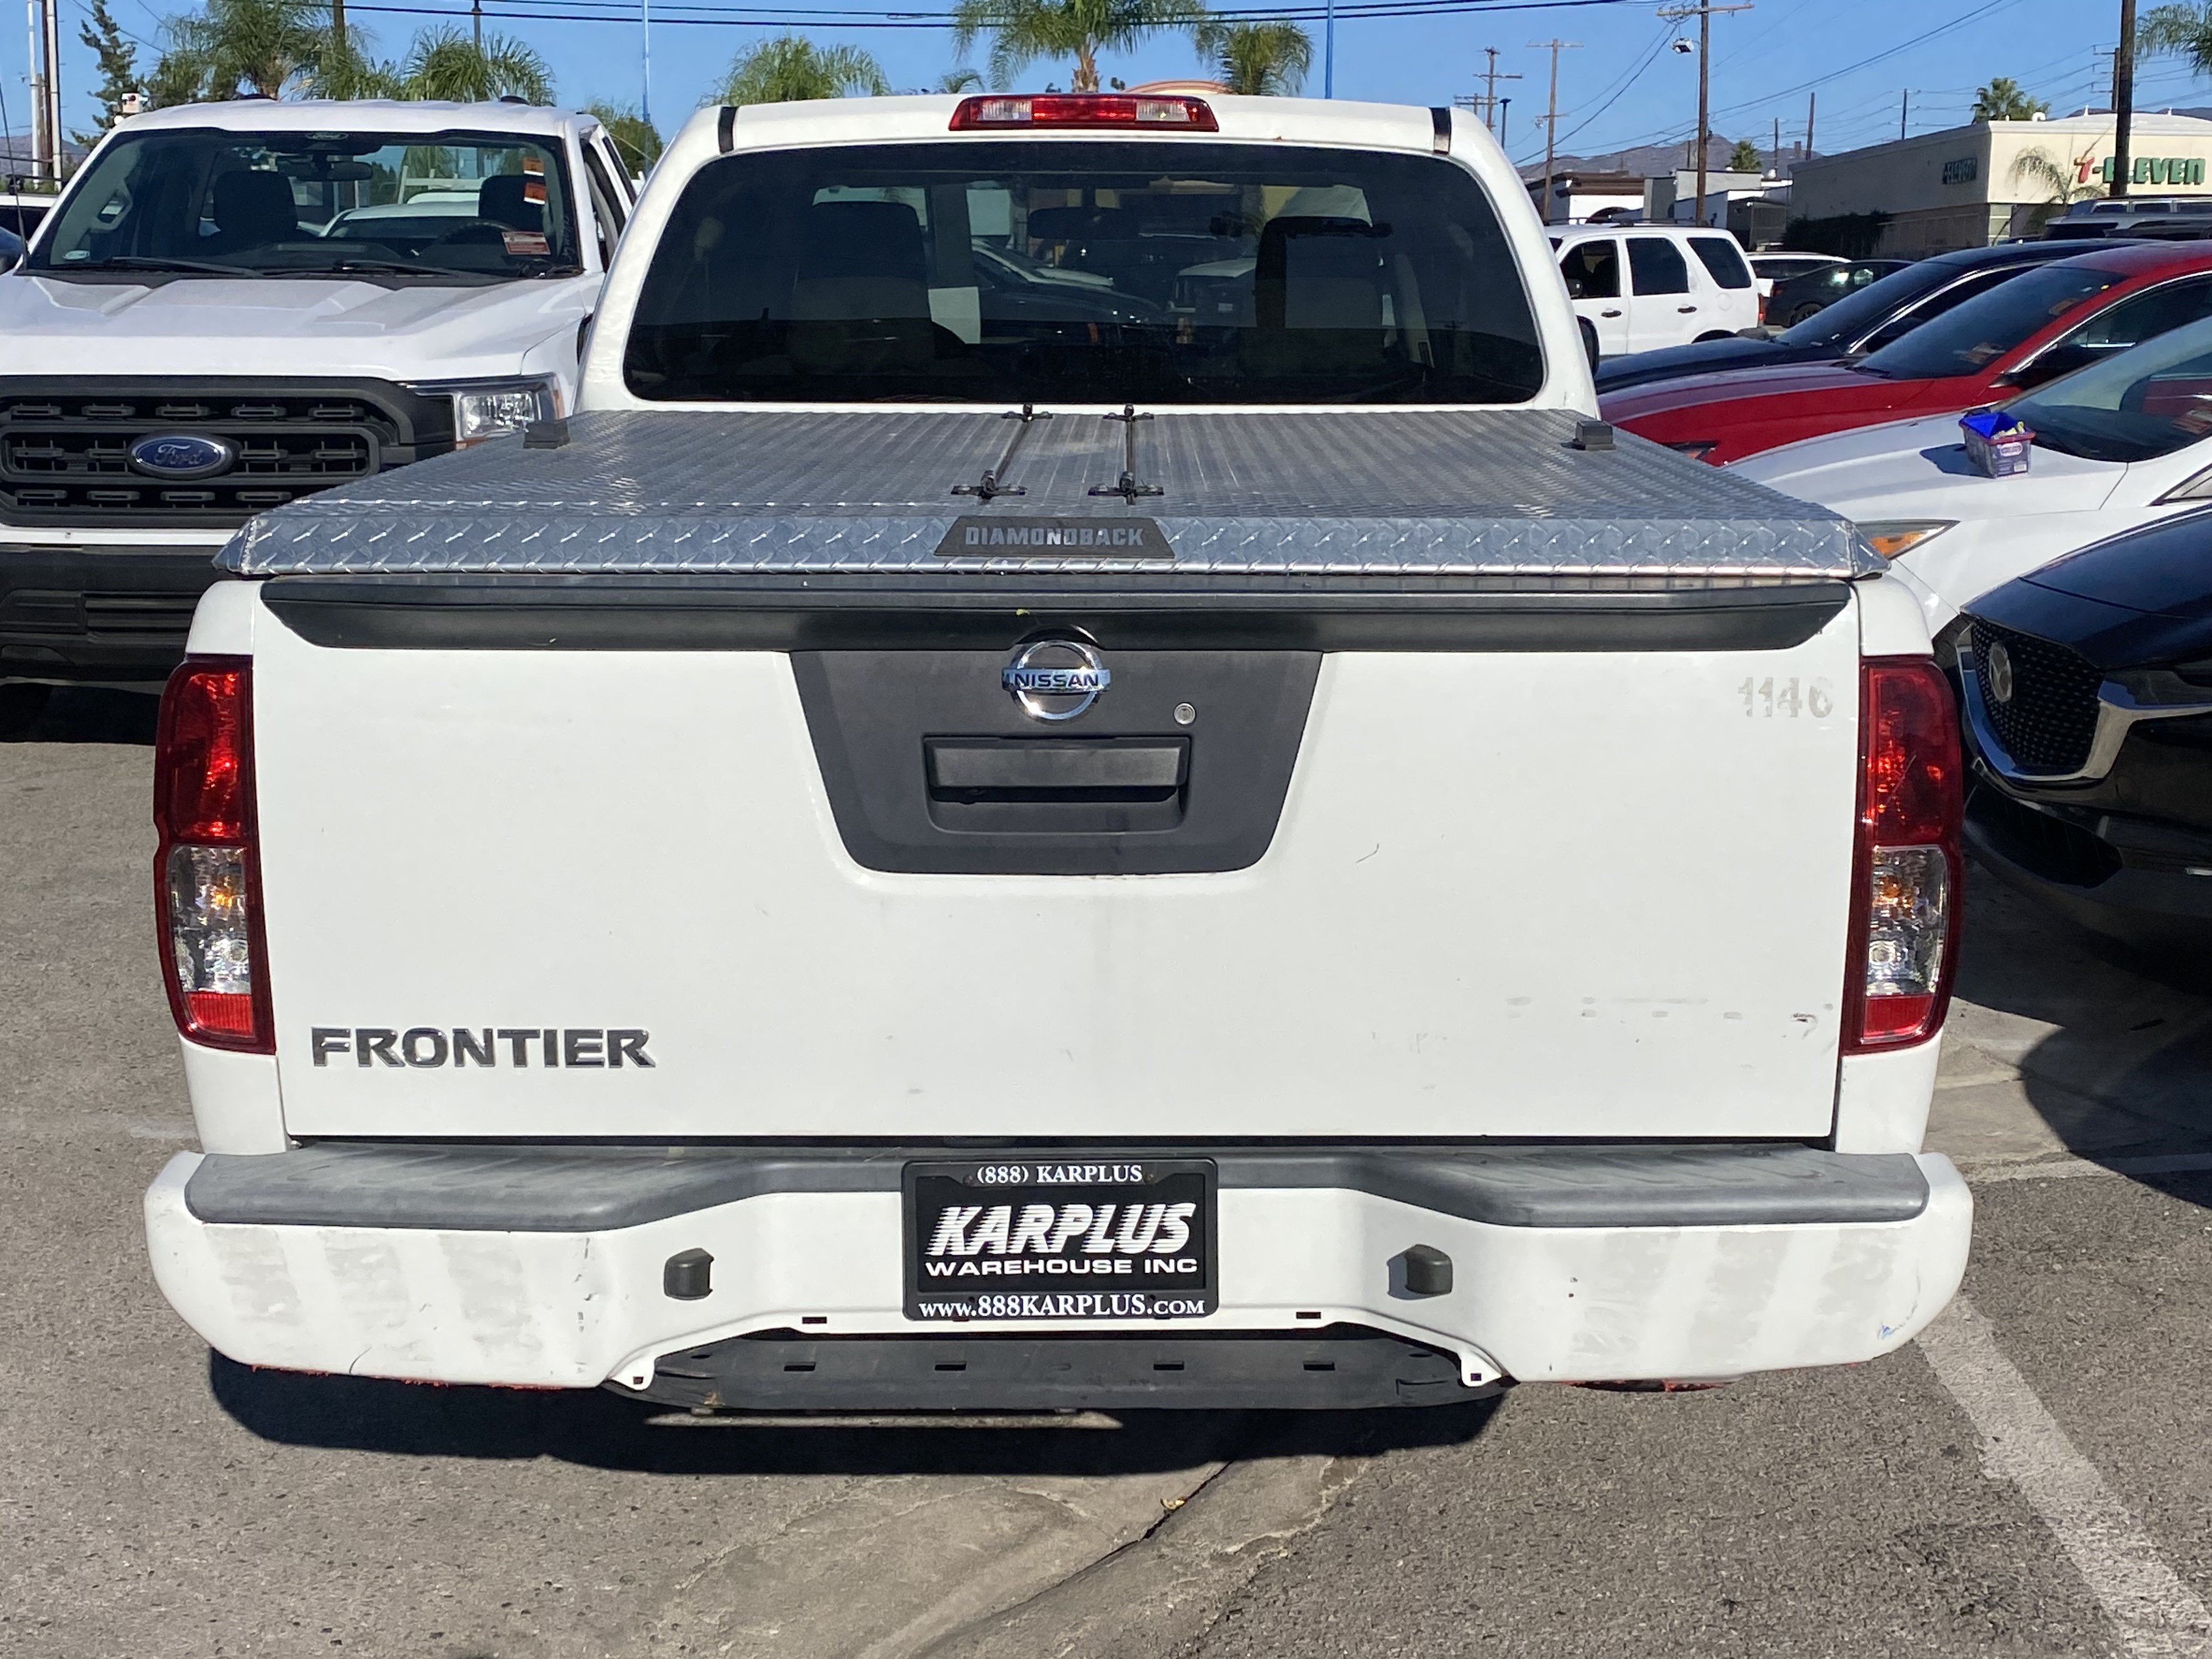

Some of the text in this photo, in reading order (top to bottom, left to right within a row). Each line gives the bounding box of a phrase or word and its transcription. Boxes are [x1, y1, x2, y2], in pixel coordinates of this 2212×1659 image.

[154, 444, 204, 465] Ford
[965, 527, 1144, 546] DIAMONDBACK
[1015, 673, 1098, 687] NISSAN
[311, 1028, 656, 1068] FRONTIER
[977, 1165, 1143, 1185] (888) KARPLUS
[924, 1202, 1197, 1256] KARPLUS
[925, 1258, 1198, 1277] WAREHOUSE INC
